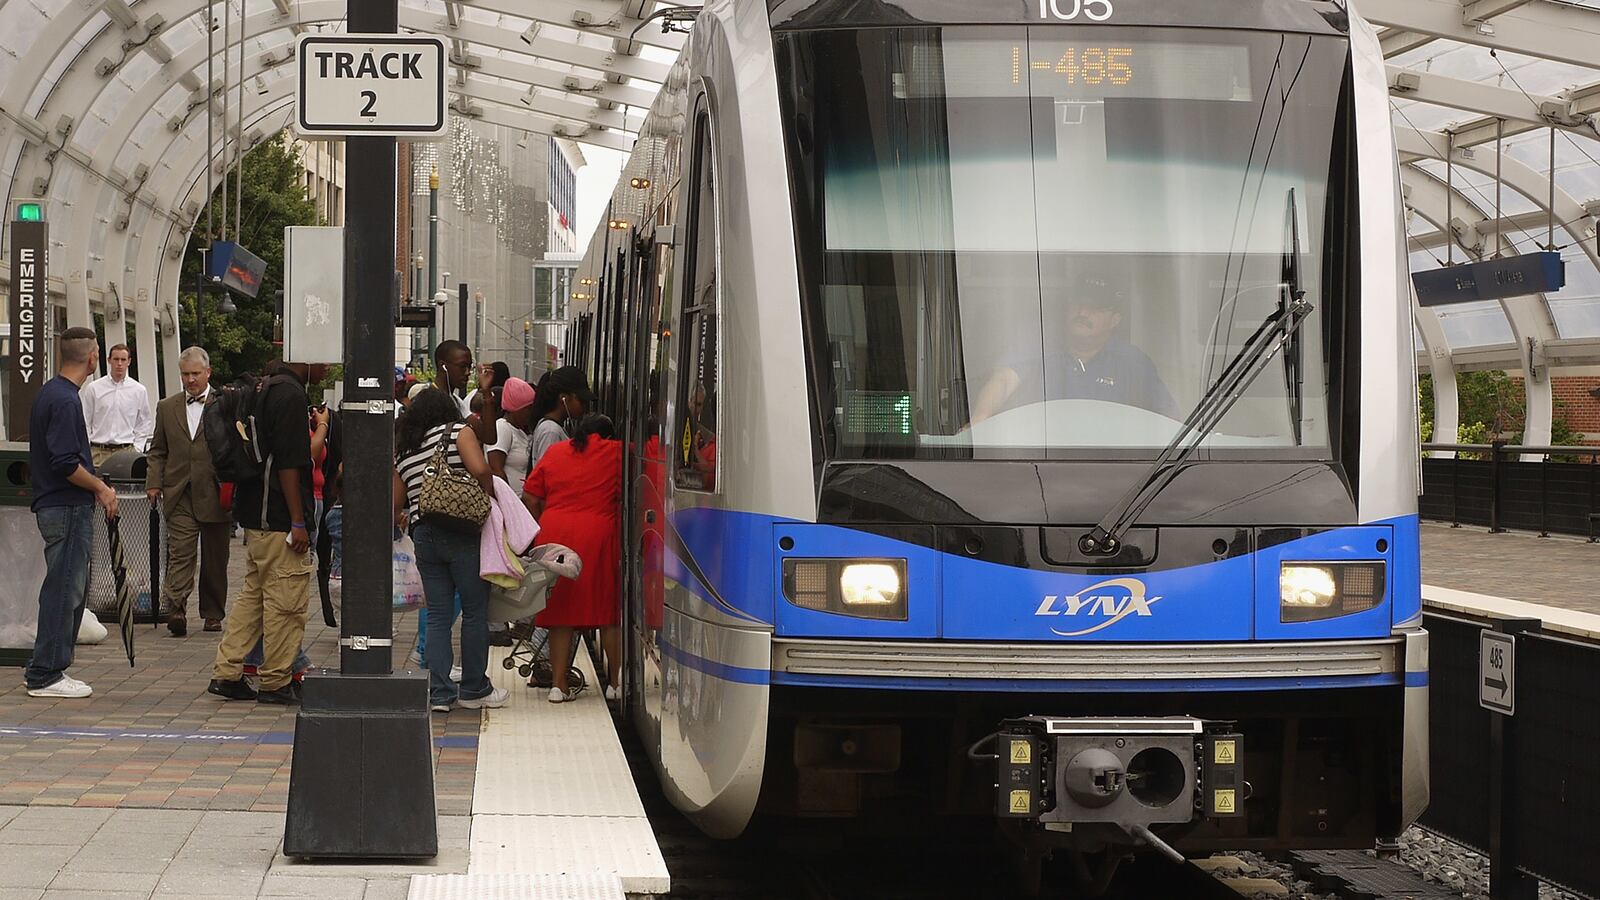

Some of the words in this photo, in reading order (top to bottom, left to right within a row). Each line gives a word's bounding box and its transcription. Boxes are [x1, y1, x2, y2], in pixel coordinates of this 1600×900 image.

[314, 52, 423, 80] TRACK
[1012, 47, 1134, 85] I-485
[360, 90, 377, 117] 2
[19, 248, 35, 383] EMERGENCY
[894, 395, 910, 434] 1
[1034, 594, 1163, 617] LYNX
[1489, 647, 1504, 670] 485
